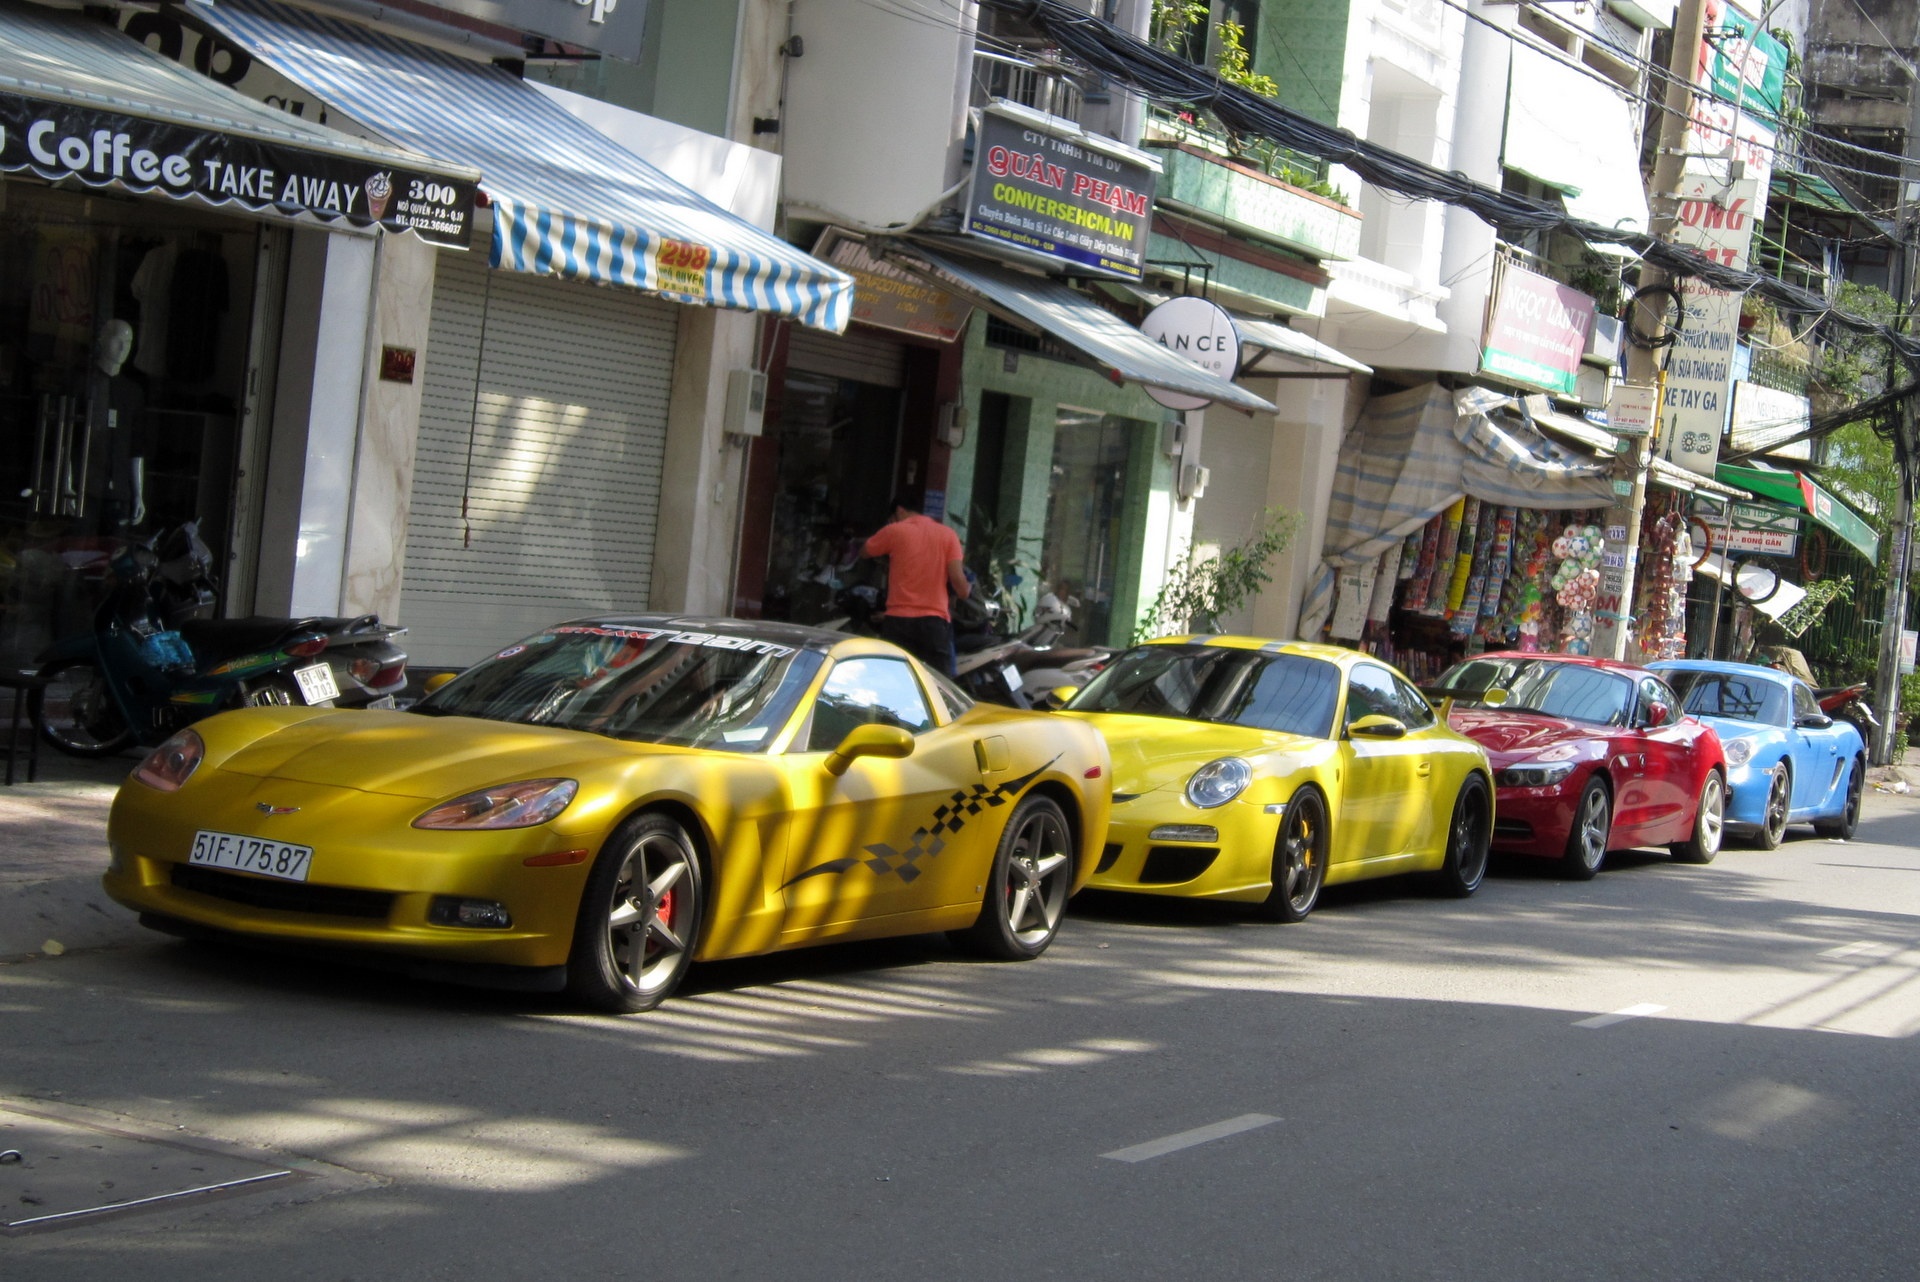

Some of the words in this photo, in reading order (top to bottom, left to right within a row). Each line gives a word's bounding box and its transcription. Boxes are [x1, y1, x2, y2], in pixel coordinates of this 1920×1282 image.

[27, 119, 192, 187] Coffee
[203, 159, 275, 200] TAKE
[282, 176, 359, 214] AWAY
[1022, 130, 1047, 147] CTY
[1051, 139, 1083, 160] TNHH
[1086, 150, 1104, 168] TM
[1106, 158, 1123, 174] DV
[408, 180, 456, 206] 300
[986, 145, 1067, 191] QUÂN
[1071, 171, 1148, 218] PHẠM
[409, 216, 462, 235] 0122.3666037
[992, 182, 1135, 242] CONVERSEHCM.VN
[660, 239, 707, 271] 298
[1143, 330, 1227, 352] ANCE
[1681, 388, 1701, 410] TAY
[1702, 391, 1718, 412] GA
[193, 833, 308, 877] 51F-175.87
